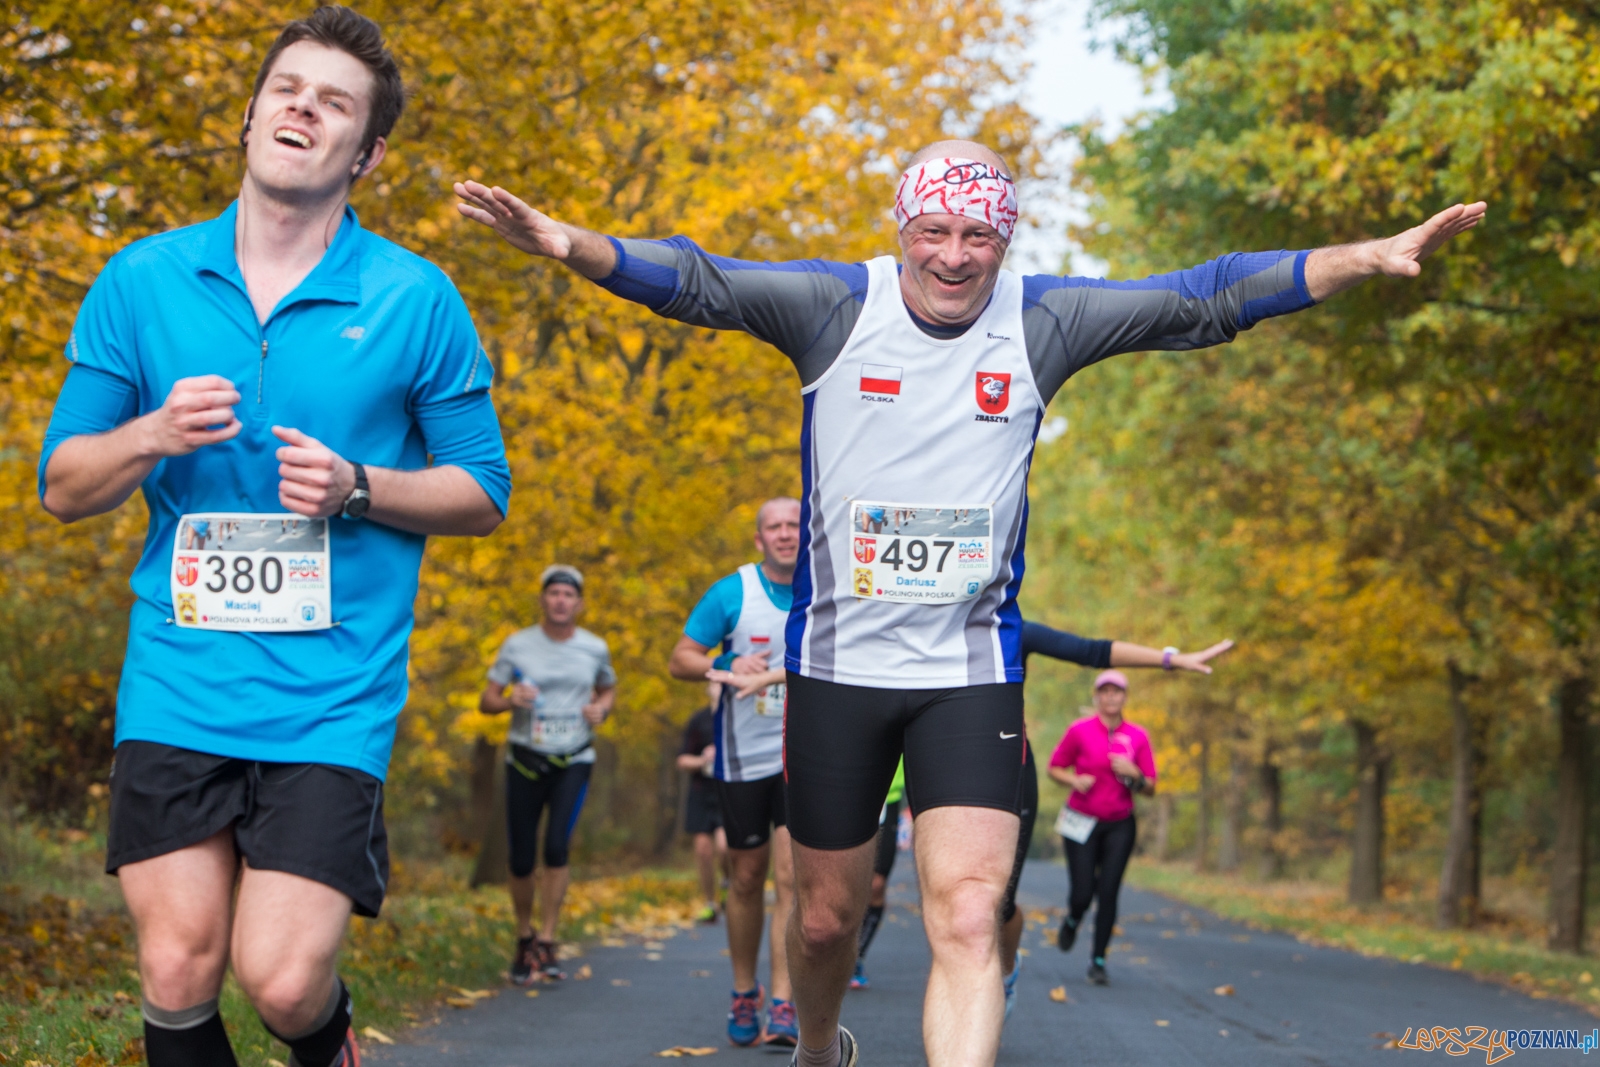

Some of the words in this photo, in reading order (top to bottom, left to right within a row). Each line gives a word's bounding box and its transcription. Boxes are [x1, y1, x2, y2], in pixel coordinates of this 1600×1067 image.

[861, 395, 895, 403] POLSKA
[974, 414, 1009, 424] ZBĄSZYŃ
[880, 538, 955, 573] 497
[205, 555, 283, 594] 380
[896, 576, 937, 587] Dariusz
[884, 589, 923, 598] POLINOVA
[925, 590, 955, 598] POLSKA
[224, 600, 261, 613] Maciej
[209, 615, 251, 624] POLINOVA
[253, 616, 288, 625] POLSKA
